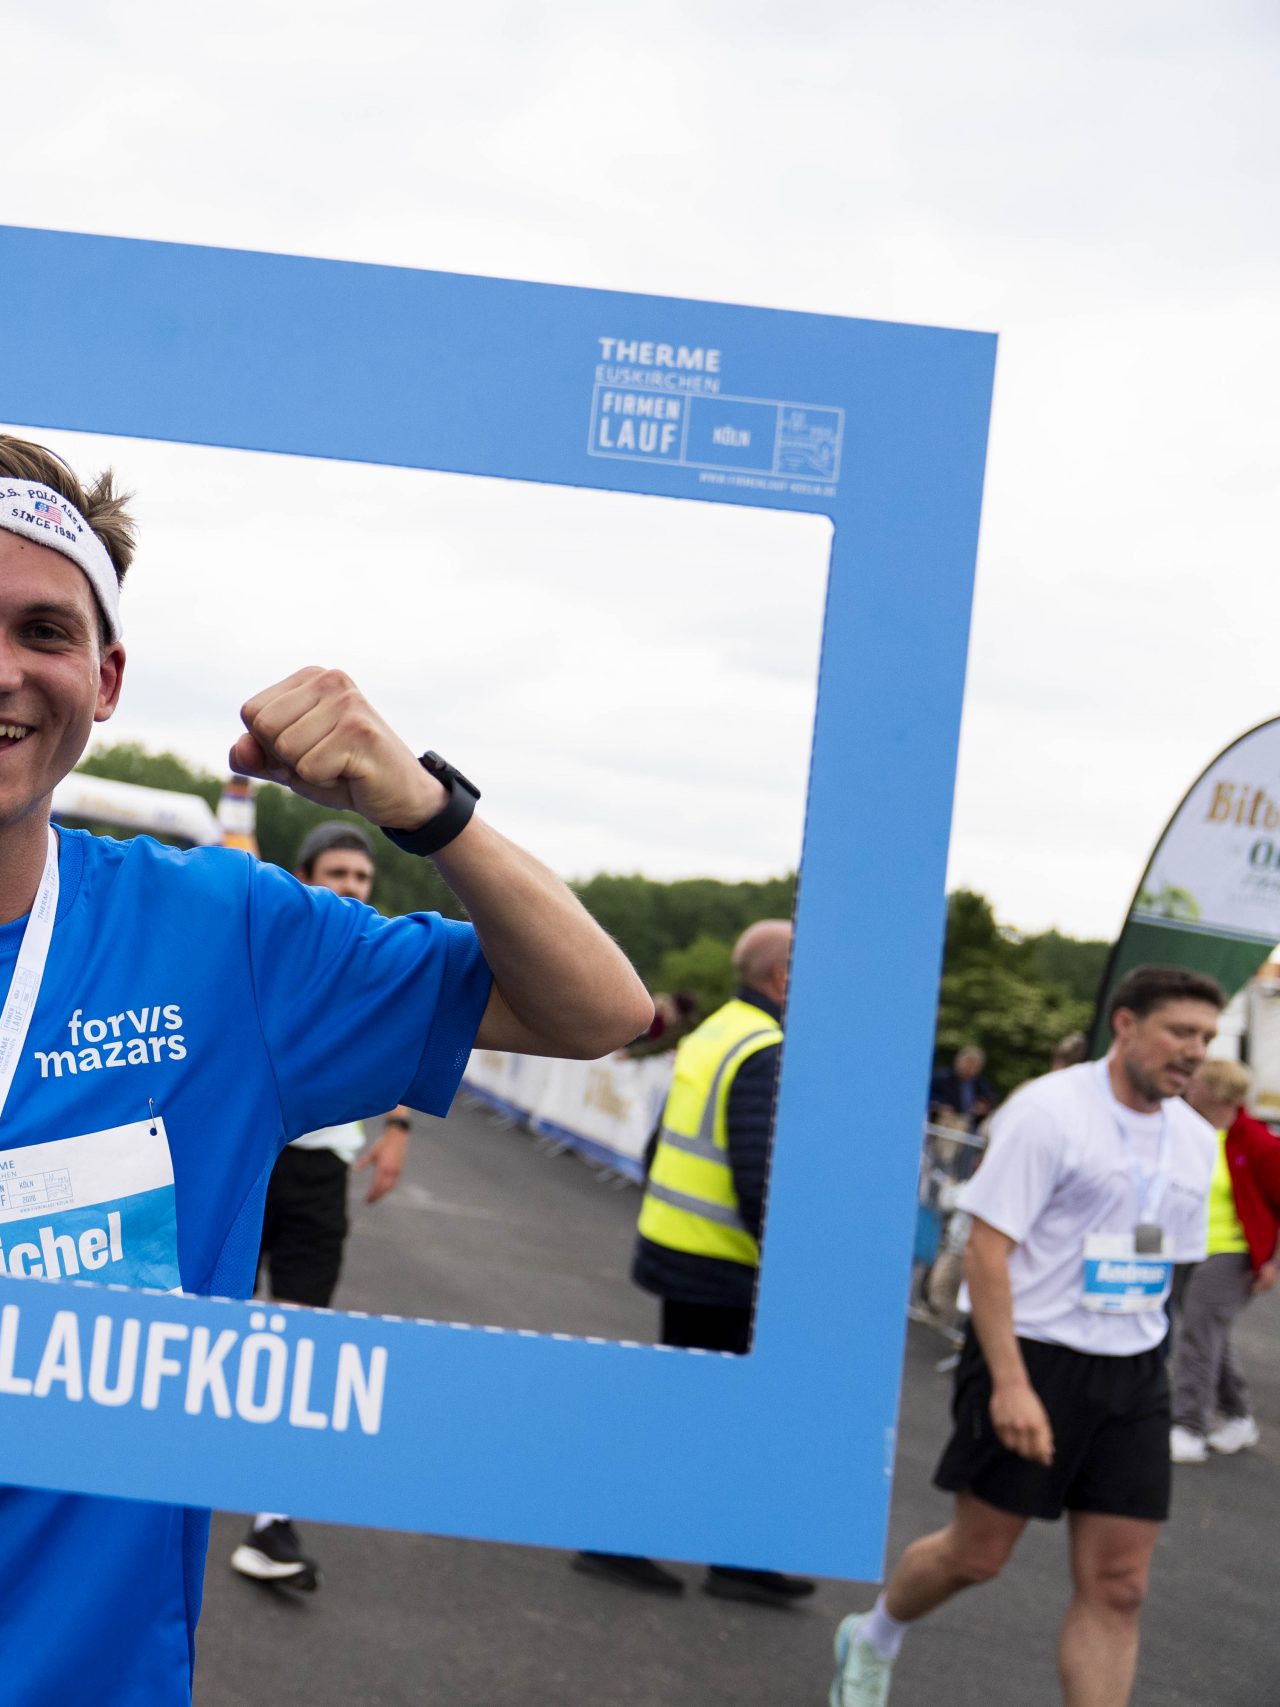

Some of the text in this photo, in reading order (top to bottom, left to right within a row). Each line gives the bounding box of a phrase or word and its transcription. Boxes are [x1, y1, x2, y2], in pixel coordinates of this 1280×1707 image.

[598, 336, 721, 373] THERME
[595, 364, 720, 394] EUSKIRCHEN
[602, 392, 681, 420] FIRMEN
[599, 416, 678, 453] LAUF
[712, 424, 751, 448] KÖLN
[28, 489, 58, 504] POLO
[11, 508, 76, 543] SINCE 1890
[10, 1010, 24, 1033] LAUF
[34, 1034, 188, 1078] mazars
